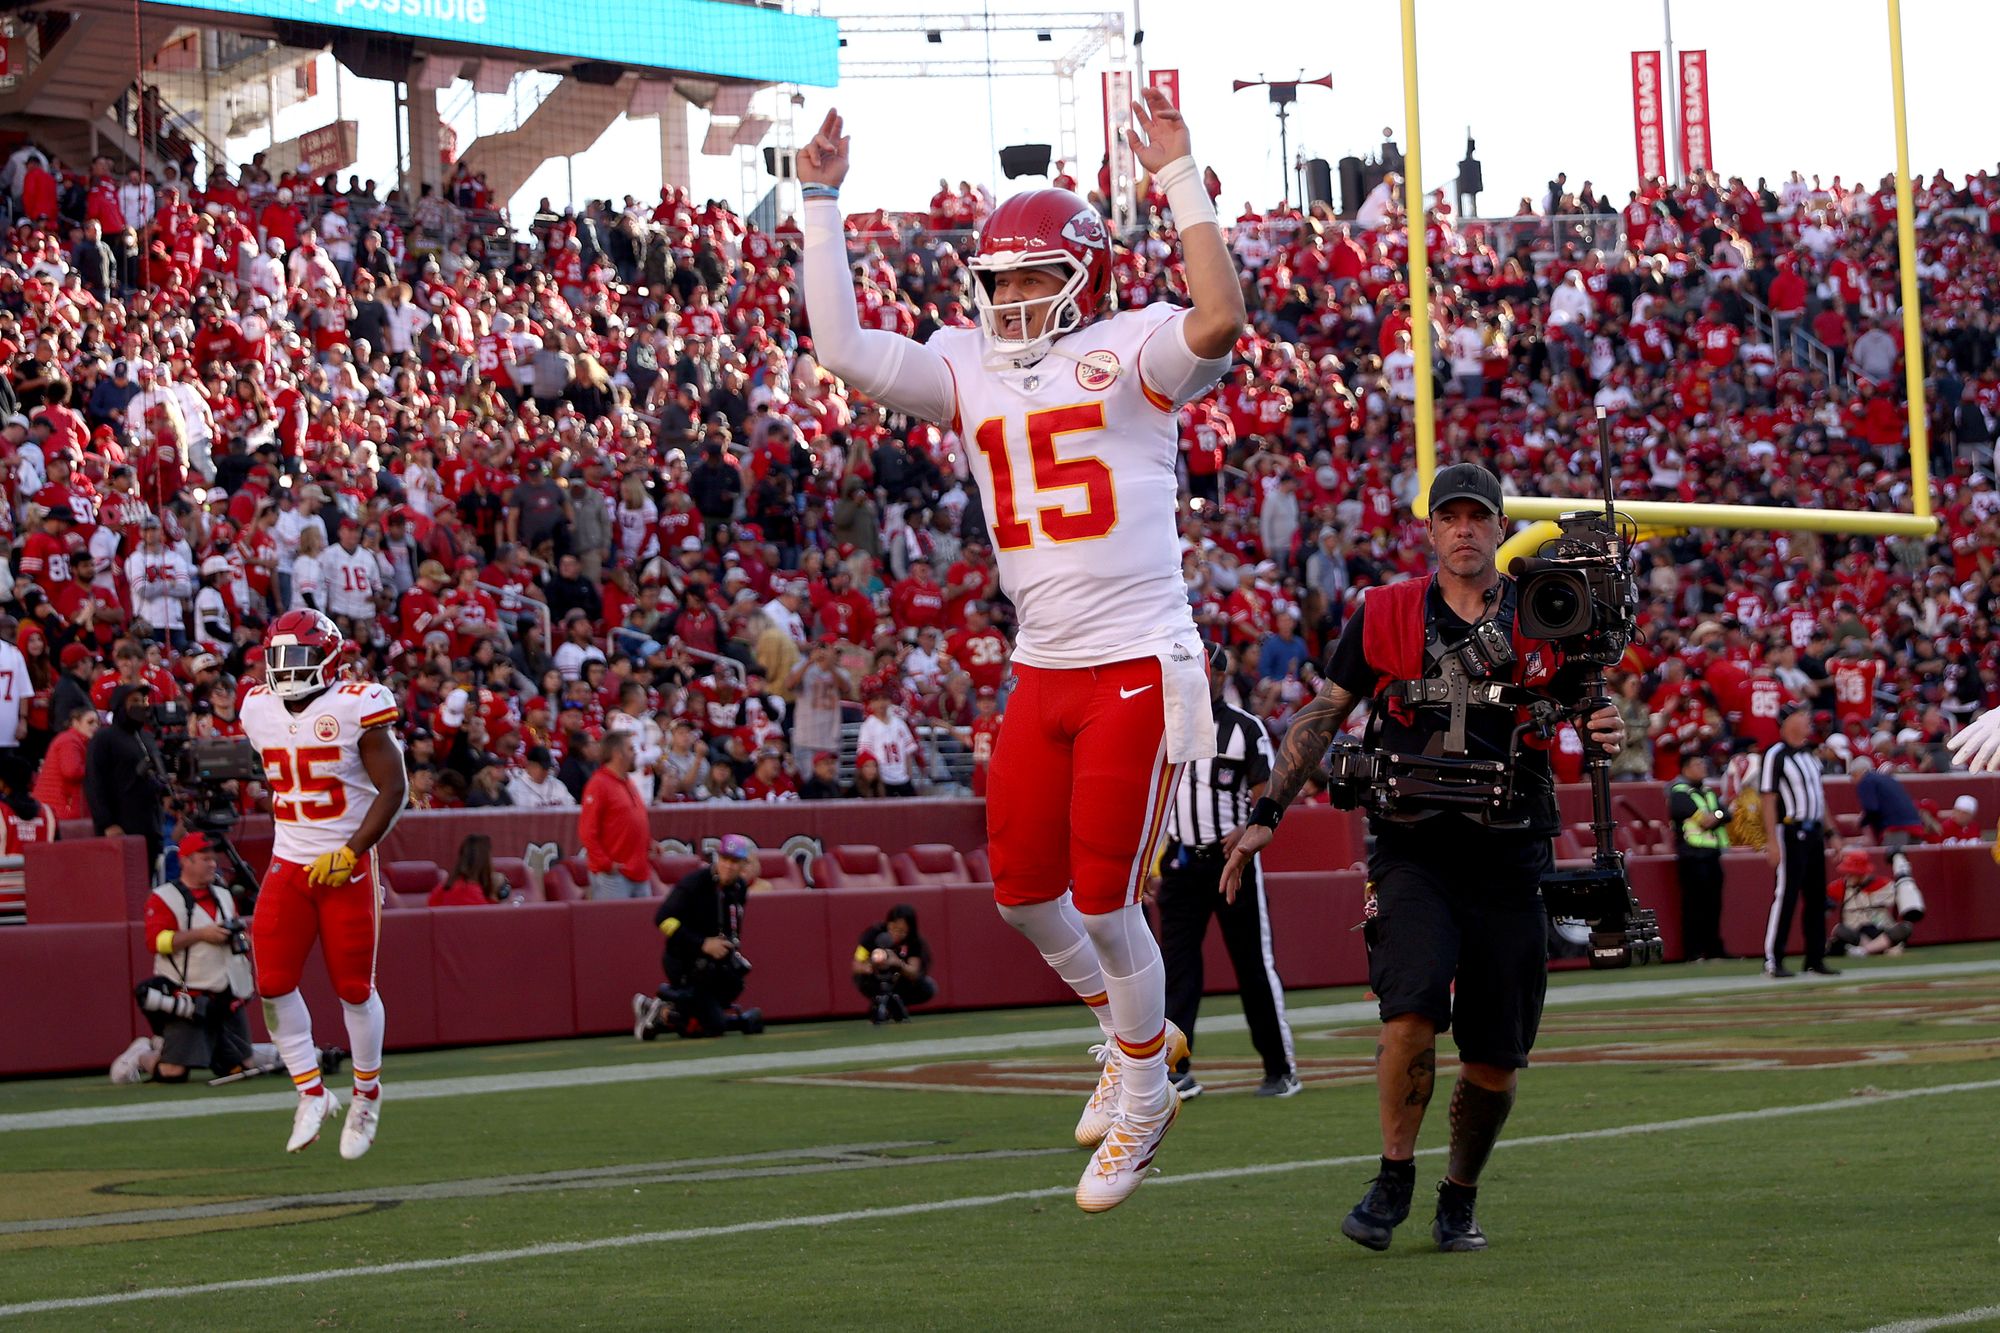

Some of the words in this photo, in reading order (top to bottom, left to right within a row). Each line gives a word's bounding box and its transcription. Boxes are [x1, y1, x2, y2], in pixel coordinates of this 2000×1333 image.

[974, 400, 1119, 553] 15
[342, 566, 370, 592] 16
[967, 636, 1002, 665] 32
[1466, 645, 1478, 662] CAM
[1751, 691, 1780, 718] 85
[261, 745, 348, 823] 25
